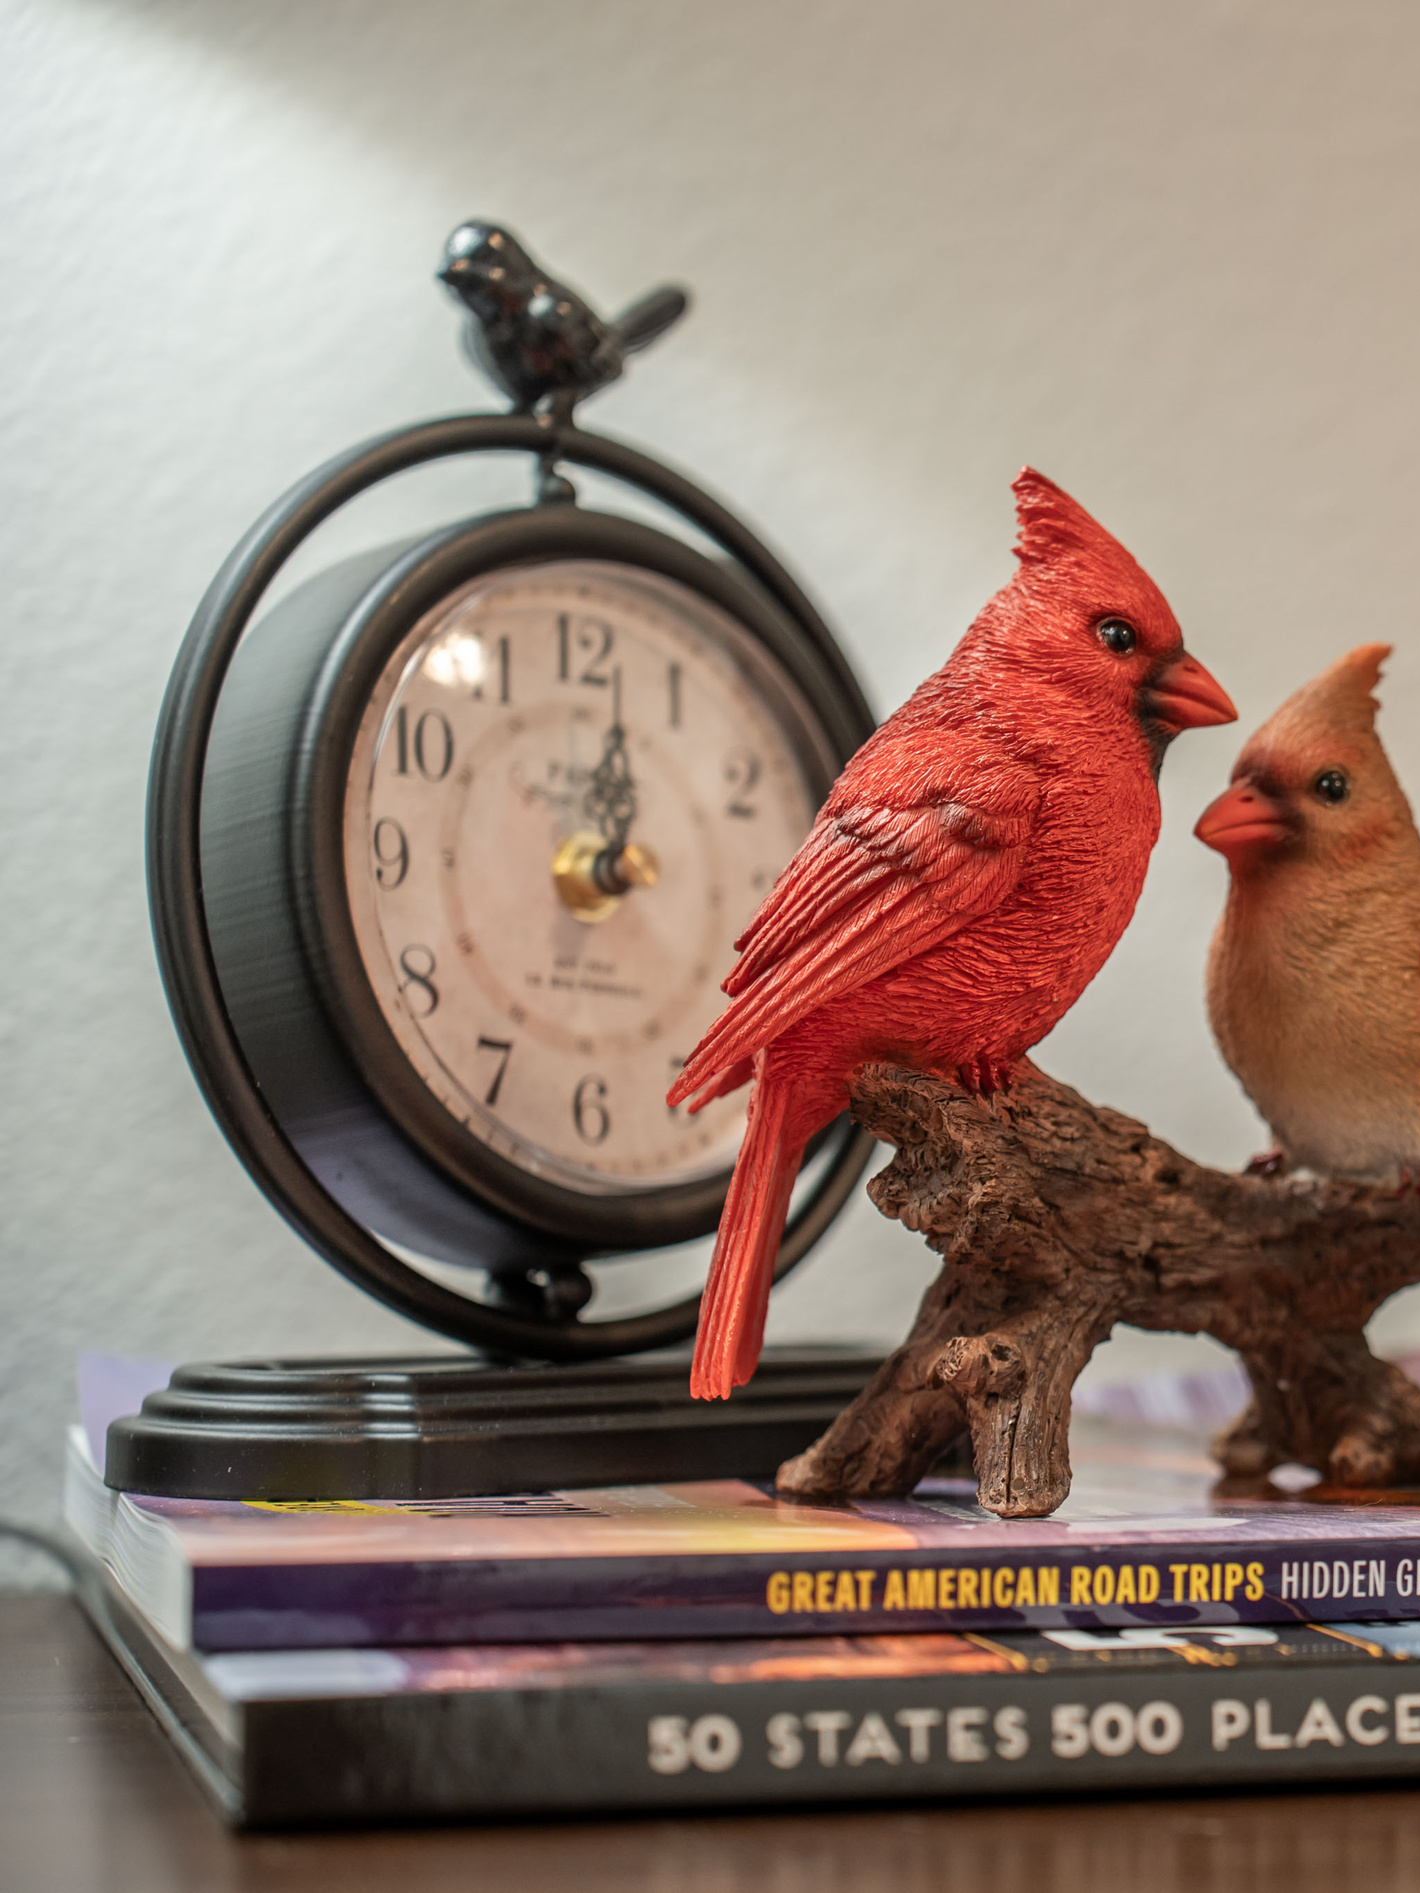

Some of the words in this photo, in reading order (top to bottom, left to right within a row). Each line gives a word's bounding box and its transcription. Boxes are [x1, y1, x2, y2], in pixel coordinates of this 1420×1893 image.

[557, 612, 614, 687] 12
[667, 661, 682, 728] 1
[396, 704, 454, 782] 10
[723, 748, 760, 819] 2
[374, 816, 409, 891] 9
[400, 943, 439, 1019] 8
[477, 1033, 513, 1106] 7
[573, 1073, 609, 1147] 6
[766, 1570, 875, 1614] GREAT
[883, 1566, 1061, 1611] AMERICAN
[1070, 1564, 1159, 1606] ROAD
[1169, 1561, 1264, 1601] TRIPS
[1281, 1559, 1386, 1599] HIDDEN
[647, 1713, 742, 1775] 50
[765, 1705, 1030, 1770] STATES
[1050, 1700, 1184, 1760] 500
